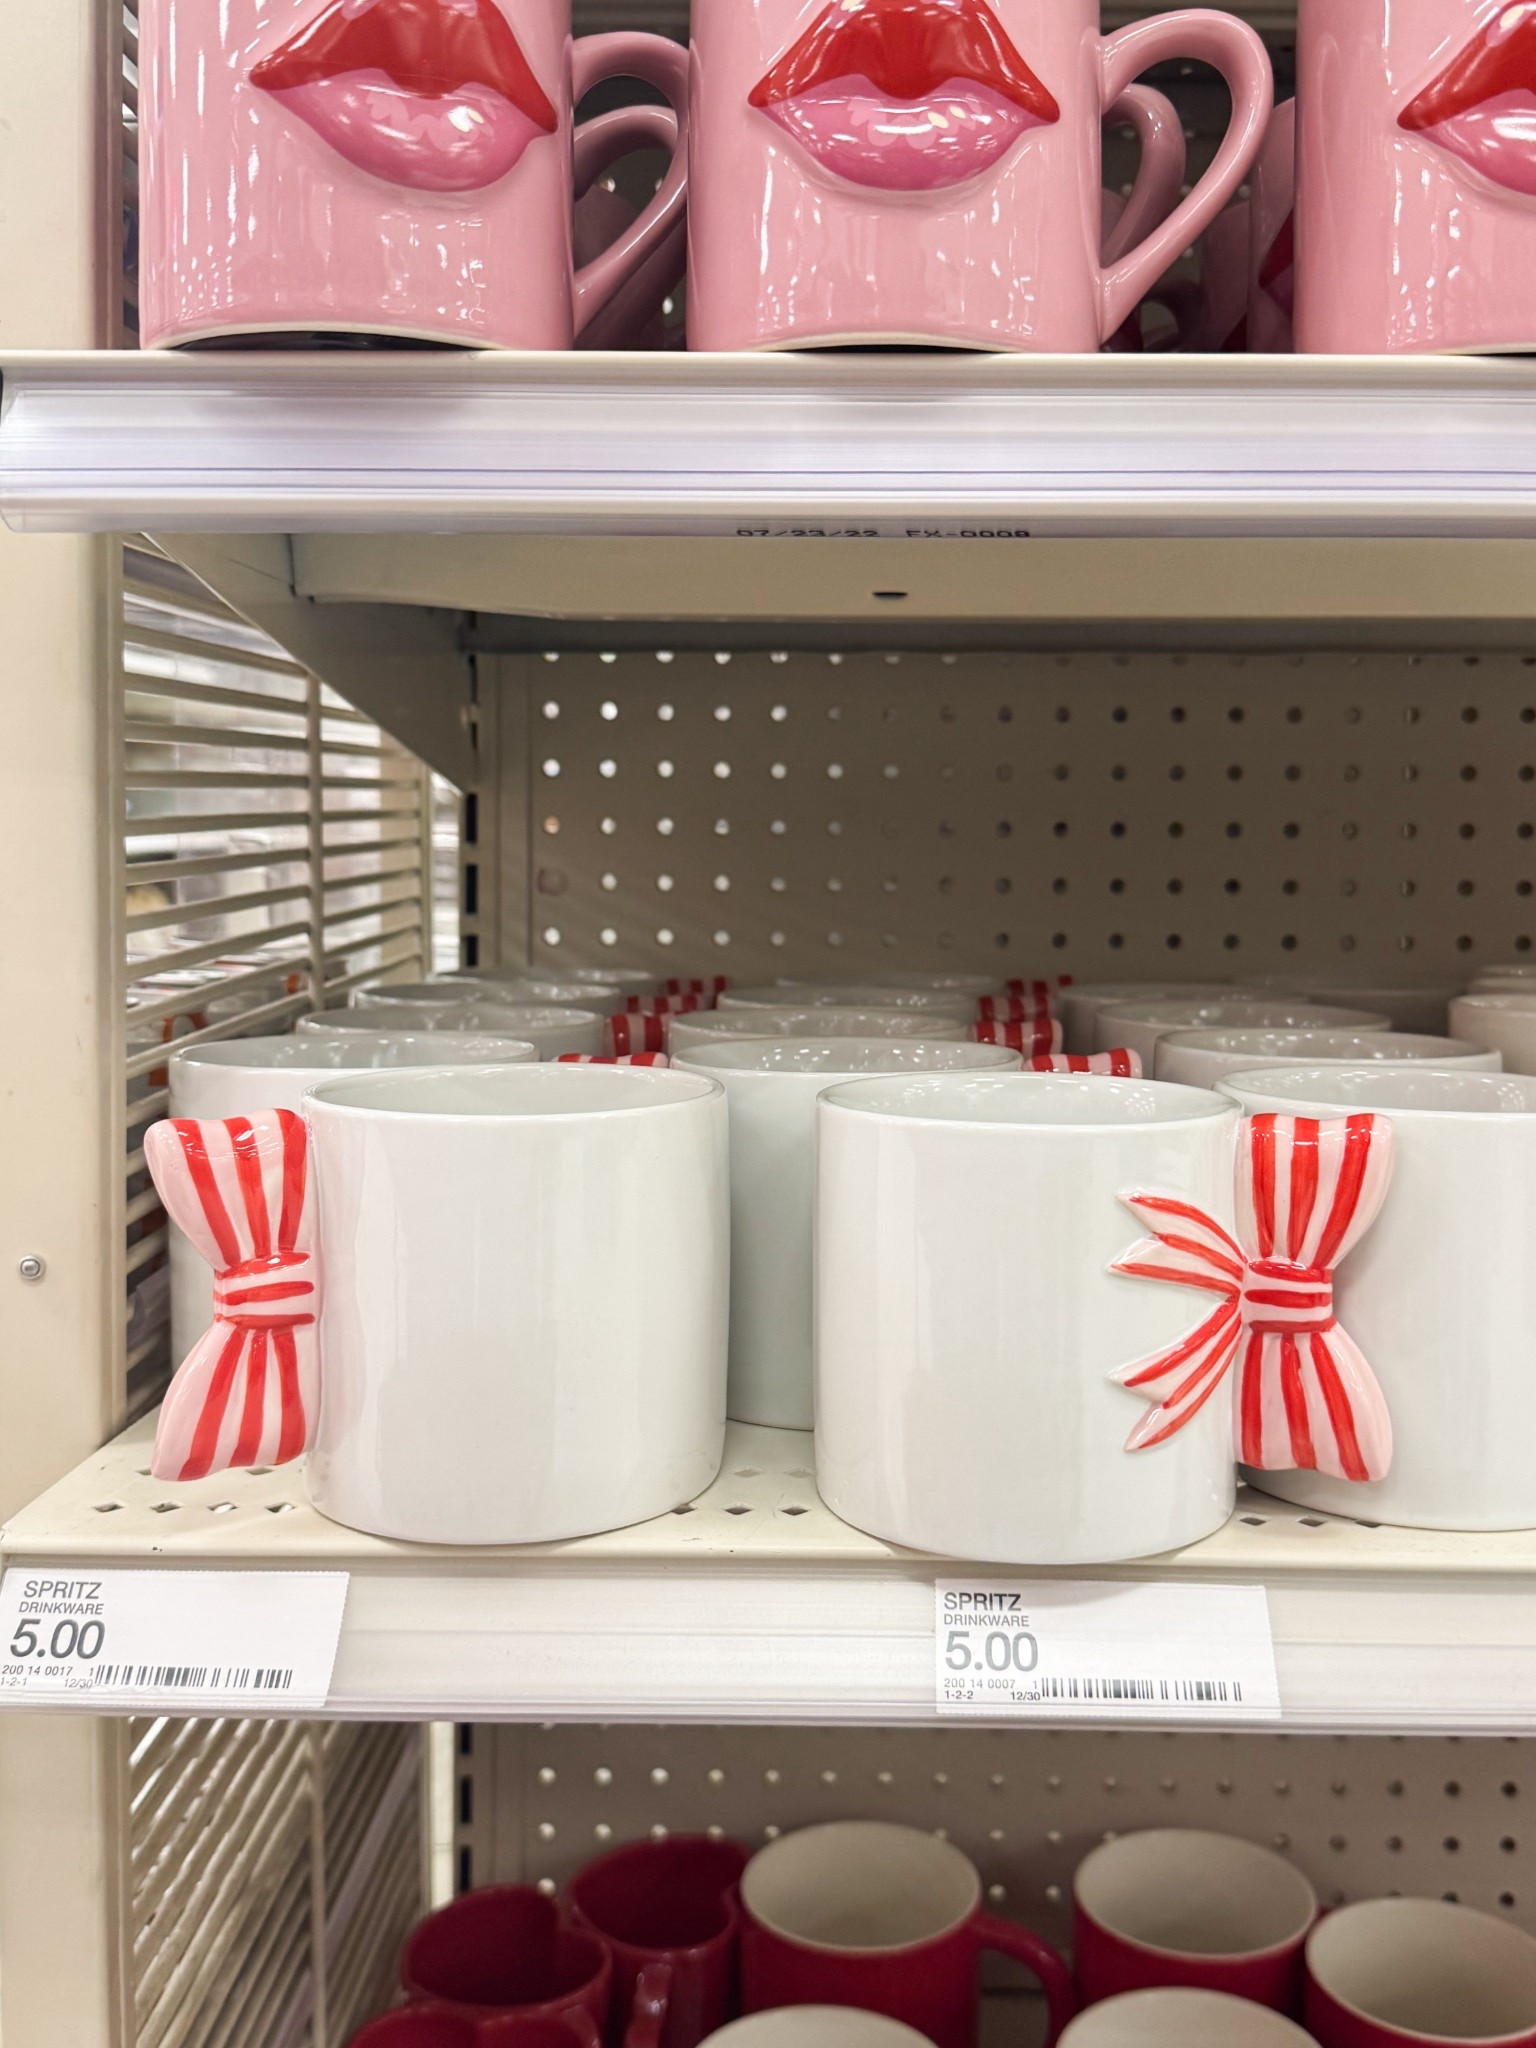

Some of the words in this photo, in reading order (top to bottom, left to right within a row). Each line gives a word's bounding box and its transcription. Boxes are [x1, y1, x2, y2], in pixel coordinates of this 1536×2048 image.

[23, 1580, 103, 1599] SPRITZ
[18, 1601, 105, 1615] DRINKWARE
[943, 1591, 1022, 1612] SPRITZ
[943, 1613, 1030, 1627] DRINKWARE
[10, 1618, 106, 1660] 5.00
[945, 1630, 1039, 1672] 5.00
[1, 1664, 24, 1675] 200
[27, 1666, 41, 1676] 14
[44, 1666, 74, 1677] 0017
[0, 1677, 28, 1687] 1-2-1
[64, 1678, 94, 1689] 12/30
[943, 1677, 966, 1689] 200
[970, 1678, 984, 1690] 14
[987, 1679, 1016, 1690] 0007
[944, 1690, 974, 1700] 1-2-2
[1010, 1691, 1041, 1701] 12/30
